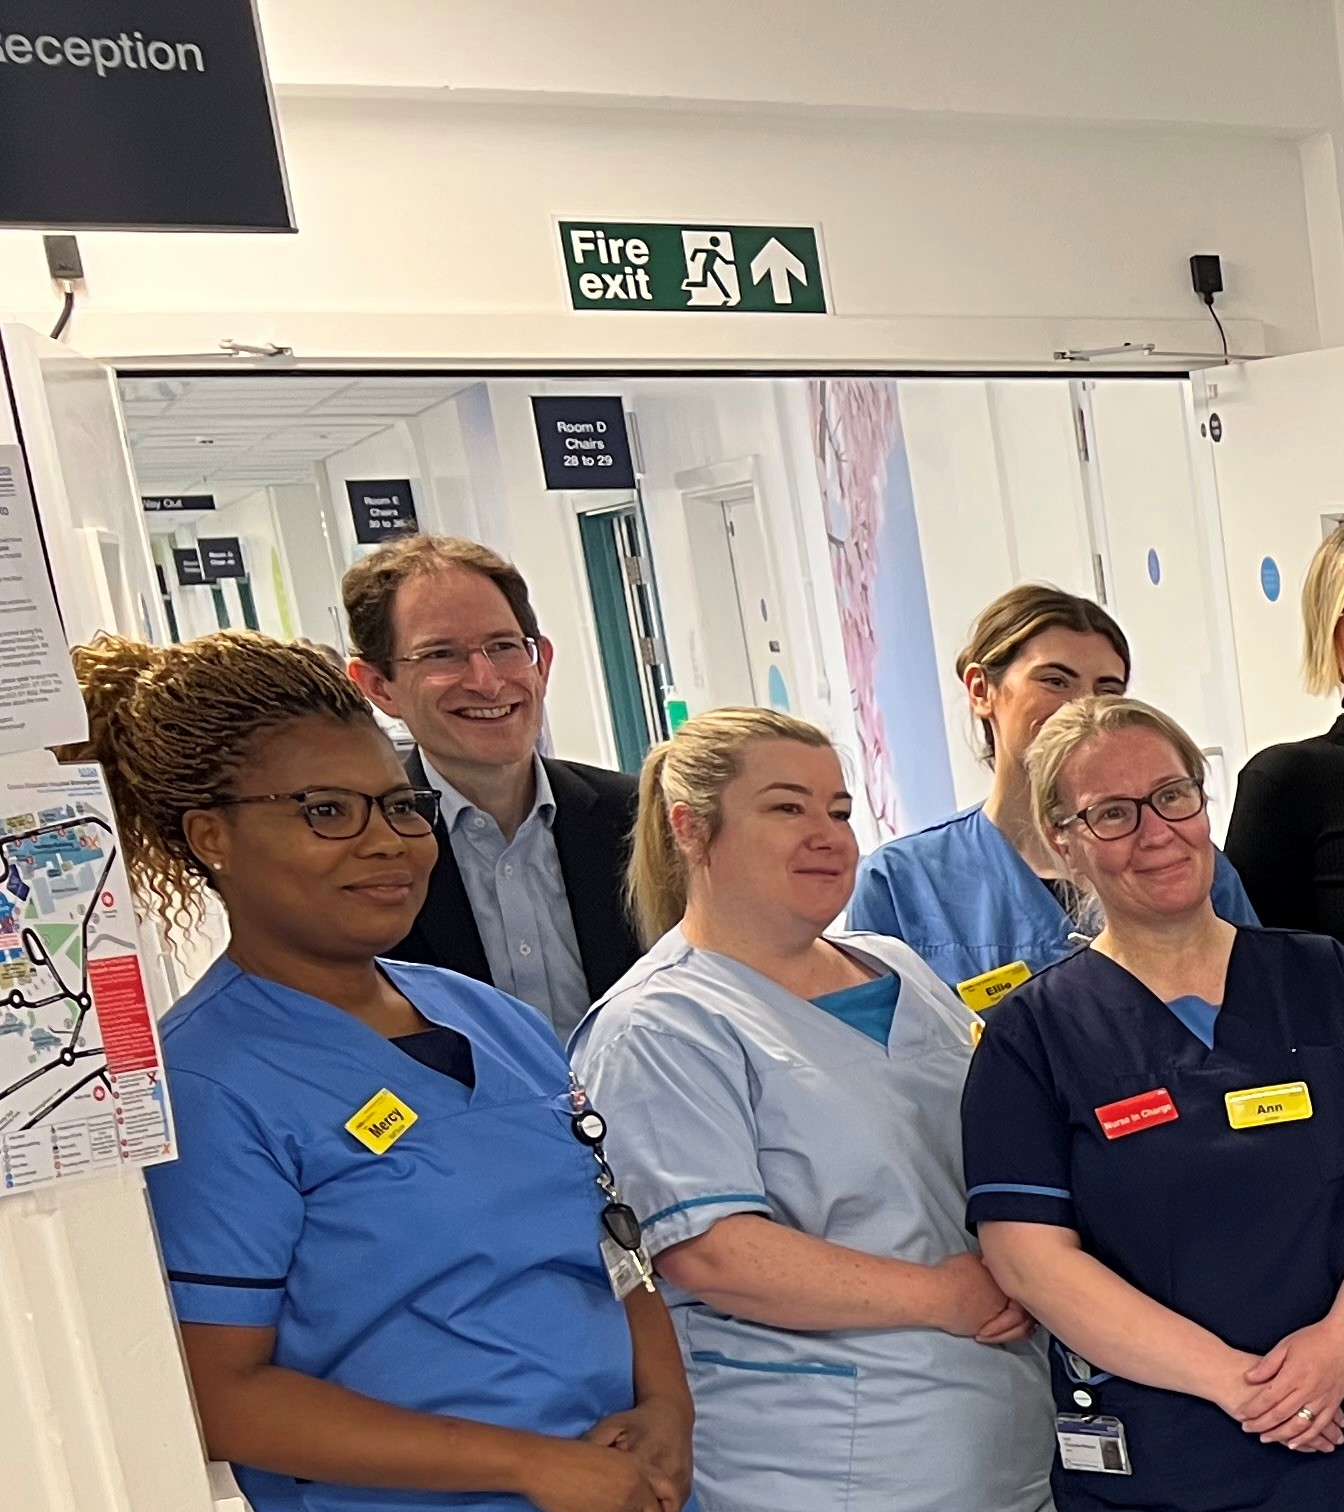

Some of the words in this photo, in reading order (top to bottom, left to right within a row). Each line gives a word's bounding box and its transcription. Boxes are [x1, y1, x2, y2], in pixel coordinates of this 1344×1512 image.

[570, 230, 650, 264] Fire
[579, 267, 652, 300] exit
[557, 421, 594, 433] Room
[596, 421, 607, 433] D
[565, 438, 605, 450] Chairs
[563, 455, 579, 467] 28
[582, 455, 595, 466] to
[597, 454, 613, 466] 29
[1257, 1104, 1284, 1115] Ann
[368, 1107, 405, 1139] Mercy
[1103, 1117, 1131, 1130] Nurse
